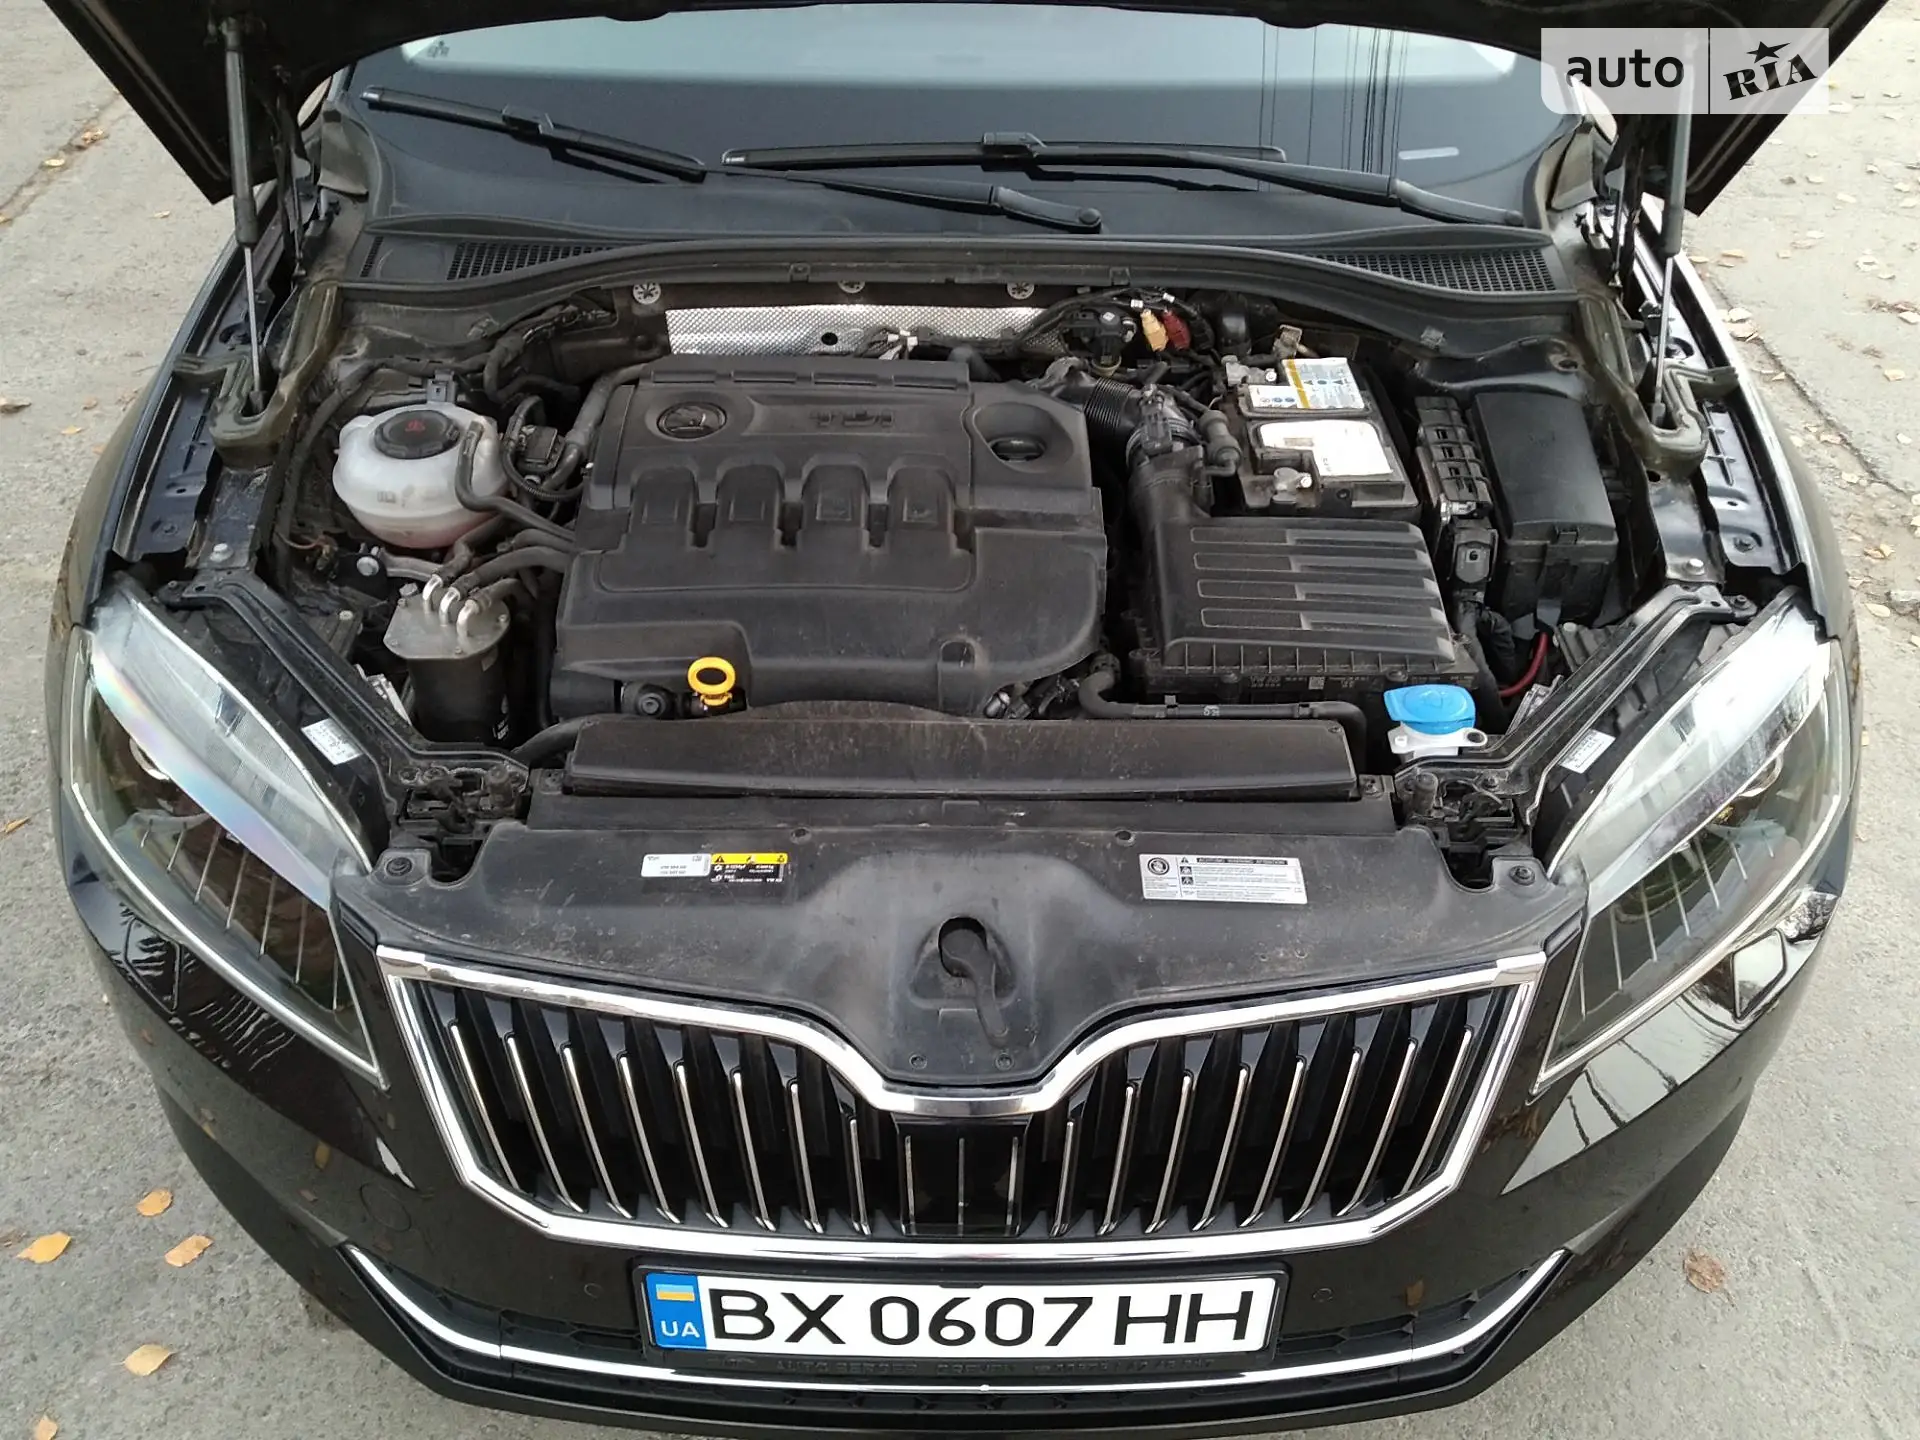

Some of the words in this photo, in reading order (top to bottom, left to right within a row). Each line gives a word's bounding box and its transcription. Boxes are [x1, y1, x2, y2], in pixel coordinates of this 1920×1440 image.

[660, 1319, 701, 1339] UA
[708, 1287, 847, 1346] BX
[869, 1295, 1093, 1348] 0607
[1114, 1289, 1254, 1346] HH
